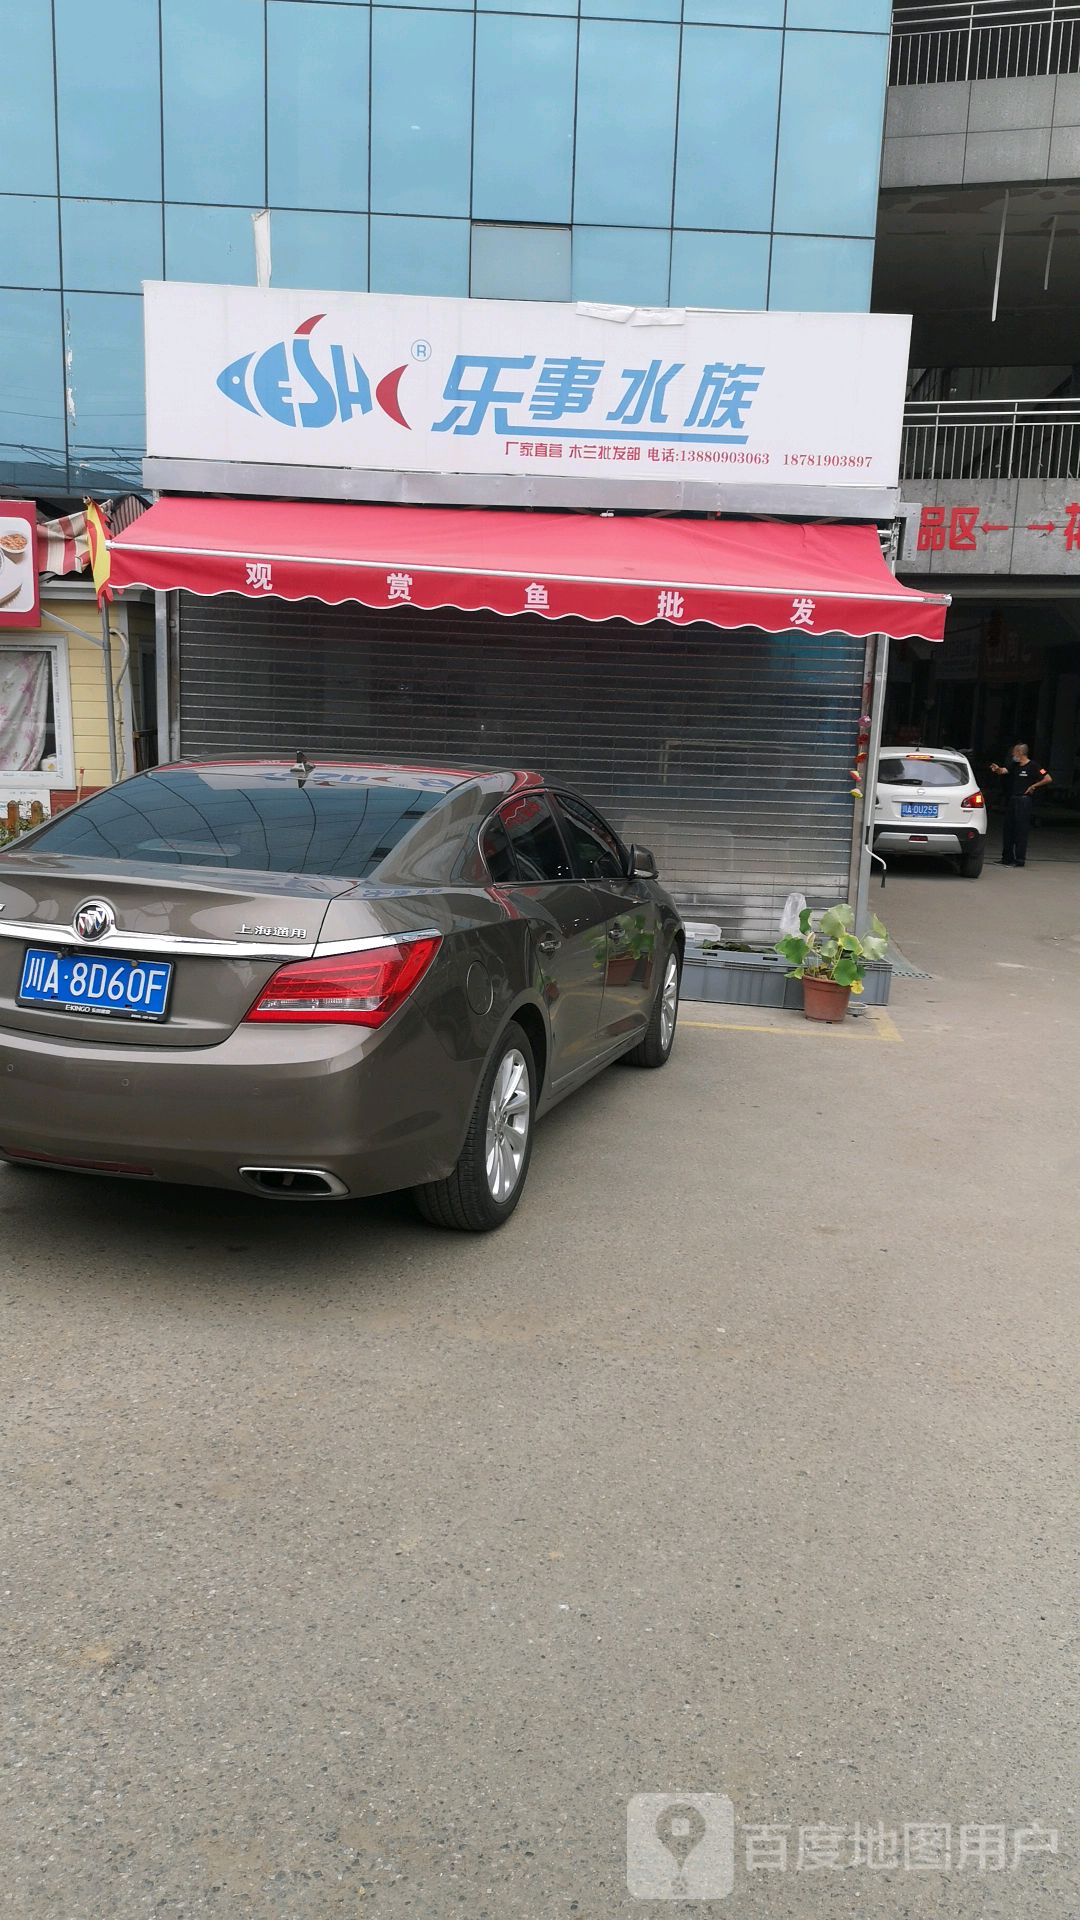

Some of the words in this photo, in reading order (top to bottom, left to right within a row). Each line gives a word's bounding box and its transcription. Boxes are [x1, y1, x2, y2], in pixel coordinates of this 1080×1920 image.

[431, 355, 765, 440] 乐事水族
[505, 441, 563, 458] 厂家直营
[783, 453, 873, 468] 18781903897
[235, 923, 307, 939] 上海通用
